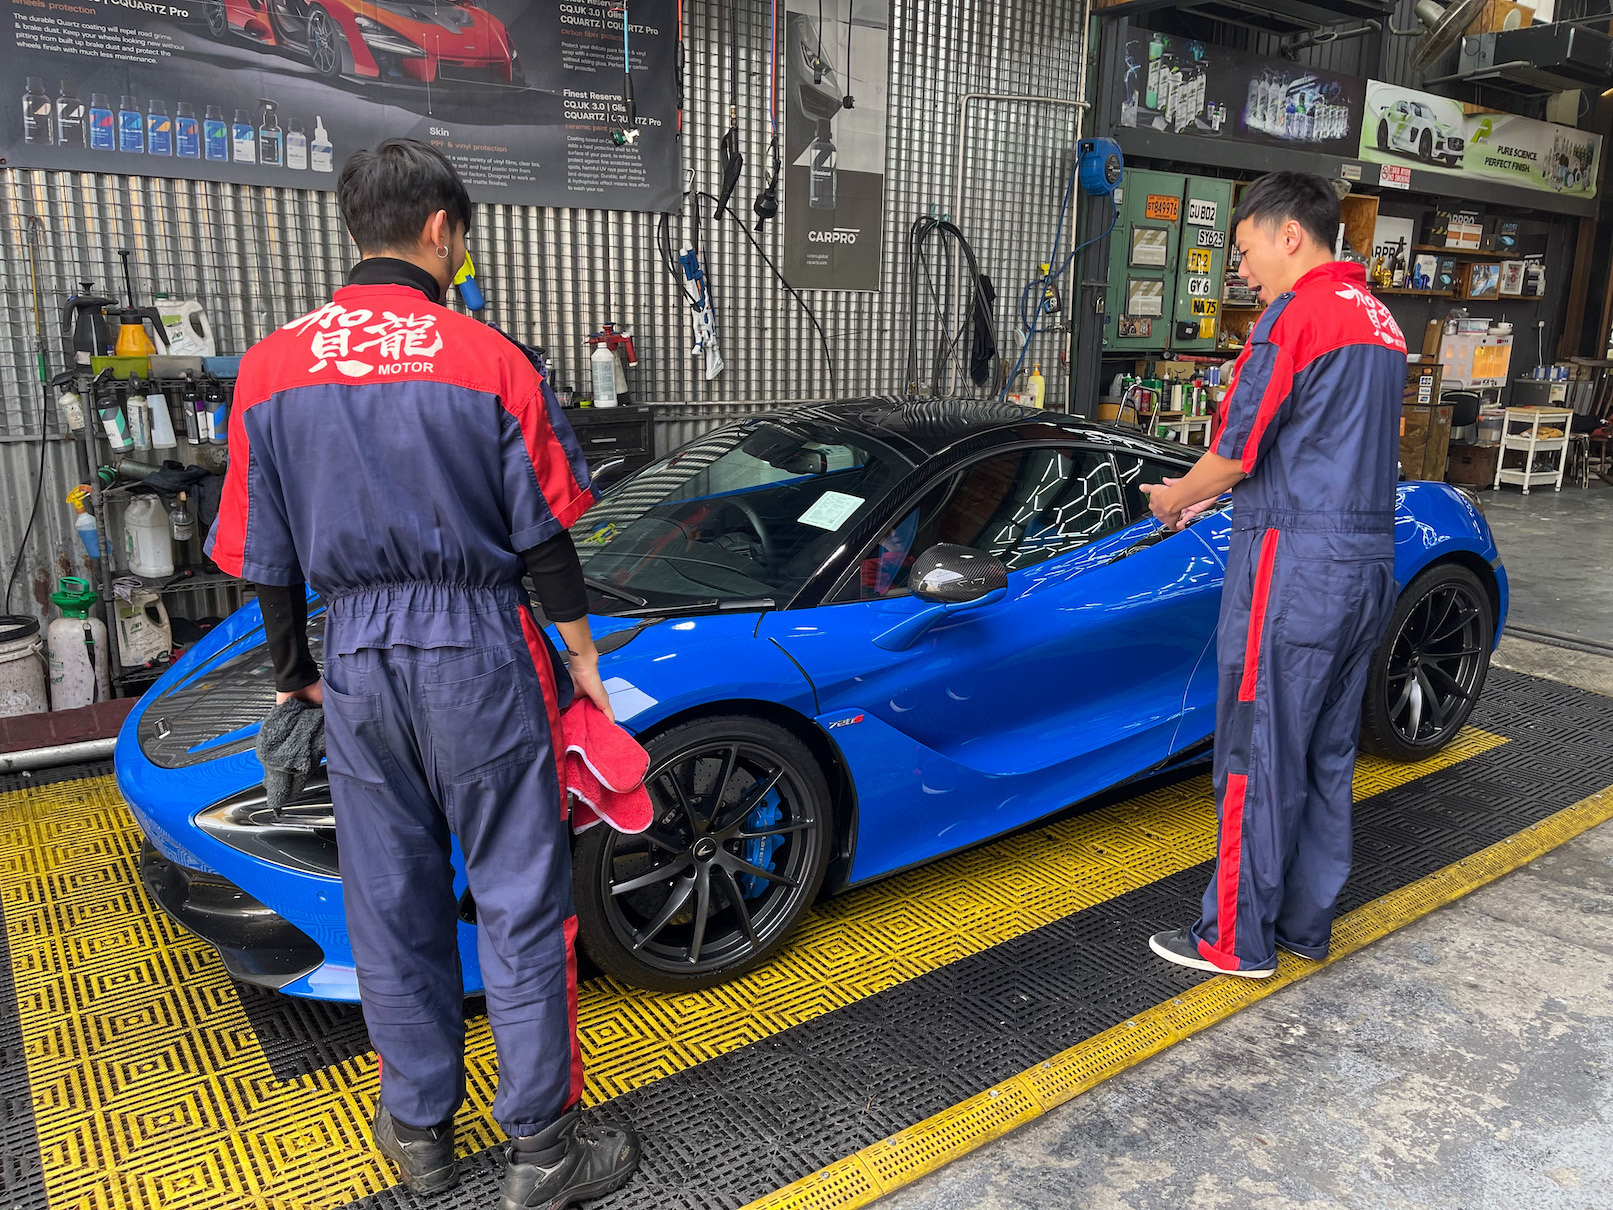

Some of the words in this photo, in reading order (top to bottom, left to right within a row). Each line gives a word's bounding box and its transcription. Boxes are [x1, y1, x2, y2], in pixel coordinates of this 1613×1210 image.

[12, 0, 46, 8] wheels
[48, 2, 96, 15] protection
[169, 7, 189, 18] Pro
[560, 4, 586, 15] CQ.UK
[589, 8, 600, 17] 3.0
[13, 12, 28, 21] The
[28, 15, 55, 24] durable
[56, 18, 80, 28] Quartz
[81, 23, 106, 33] coating
[119, 28, 137, 36] repel
[153, 33, 172, 41] grime
[560, 15, 600, 28] CQUARTZ
[607, 21, 644, 34] CQURTZ
[646, 27, 659, 35] Pro
[22, 23, 43, 32] brake
[43, 26, 61, 34] dust.
[62, 28, 80, 37] Keep
[81, 31, 97, 39] your
[97, 34, 121, 42] wheels
[122, 36, 146, 46] looking
[161, 42, 185, 51] without
[561, 29, 583, 37] carbon
[16, 32, 39, 41] pitting
[40, 34, 57, 43] from
[58, 37, 74, 45] built
[85, 41, 104, 49] brake
[122, 45, 135, 53] and
[136, 47, 159, 56] protect
[16, 41, 41, 50] wheels
[43, 43, 62, 52] finish
[79, 48, 99, 57] much
[100, 51, 114, 59] less
[115, 53, 158, 64] maintenance.
[563, 89, 588, 99] Finest
[590, 92, 622, 102] Reserve
[563, 100, 590, 110] CQ.UK
[612, 104, 626, 112] Glis
[564, 111, 605, 121] CQUARTZ
[649, 118, 662, 127] Pro
[429, 127, 450, 137] Skin
[430, 139, 445, 147] PPF
[473, 144, 508, 153] protection
[1497, 146, 1513, 157] PURE
[1514, 148, 1538, 161] SCIENCE
[1484, 157, 1511, 170] PERFECT
[1512, 161, 1530, 173] FINISH
[488, 173, 510, 181] Designed
[808, 230, 857, 245] CARPRO
[1372, 246, 1396, 259] RPR
[1203, 254, 1209, 267] 2
[1190, 279, 1201, 293] GY
[1203, 280, 1209, 293] 6
[1193, 300, 1205, 314] NA
[1206, 302, 1217, 314] 75
[282, 301, 444, 378] 賀龍
[378, 361, 434, 376] MOTOR
[829, 714, 864, 730] 720S
